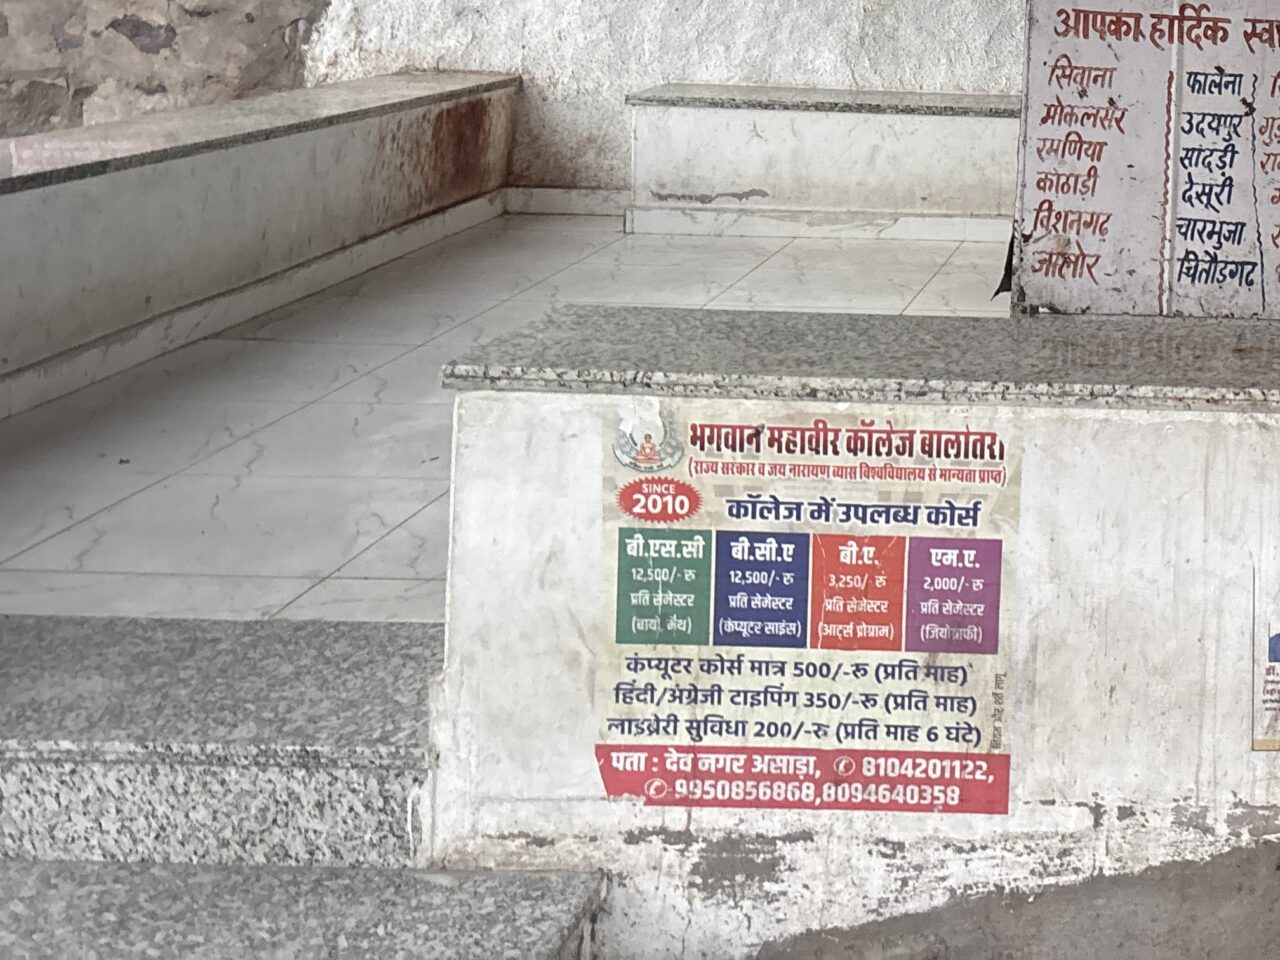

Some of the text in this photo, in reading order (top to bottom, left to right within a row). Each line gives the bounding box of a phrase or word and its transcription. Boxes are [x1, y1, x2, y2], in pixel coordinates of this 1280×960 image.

[1054, 9, 1143, 42] आपका
[1150, 3, 1231, 51] हार्दिक
[1048, 54, 1117, 89] सिवाना
[1186, 71, 1243, 95] फालना
[1181, 112, 1244, 142] उदयपुर
[1036, 130, 1108, 162] रमणिया
[1182, 171, 1234, 213] देसूरी
[1176, 217, 1246, 250] चारभुजा
[1031, 240, 1101, 285] जालोर
[690, 423, 764, 452] भगवान
[768, 419, 841, 455] महावीर
[846, 419, 916, 458] कॉलेज
[688, 457, 718, 477] (राज्य
[721, 461, 755, 476] सरकार
[758, 464, 765, 475] व
[768, 463, 785, 476] जय
[789, 463, 830, 478] नारायण
[833, 466, 857, 479] व्यास
[928, 464, 936, 481] से
[939, 468, 976, 482] मान्यता
[632, 494, 689, 514] 2010
[642, 484, 675, 493] SINCE
[726, 494, 982, 526] कॉलेज में उपलब्ध कोर्स
[626, 534, 705, 558] बी.एस.सी
[731, 536, 795, 562] बी.सी.ए
[930, 548, 980, 568] एम.ए.
[631, 590, 695, 606] प्रति सेमेस्टर
[729, 593, 793, 609] प्रति सेमेस्टर
[824, 597, 889, 613] प्रति सेमेस्टर
[921, 600, 985, 616] प्रति सेमेस्टर
[626, 653, 693, 679] कंप्यूटर
[699, 653, 744, 675] कोर्स
[749, 660, 786, 676] मात्र
[875, 659, 919, 683] (प्रति
[924, 667, 967, 685] माह)
[614, 680, 723, 706] हिंदी/अंग्रेजी
[730, 683, 799, 707] टाइपिंग
[884, 690, 930, 714] (प्रति
[935, 697, 976, 715] माह)
[685, 715, 748, 742] सुविधा
[836, 718, 879, 743] (प्रति
[885, 726, 920, 742] माह
[927, 728, 938, 742] 6
[945, 721, 981, 748] घंटे)
[611, 752, 648, 771] पता
[664, 748, 694, 772] देव
[698, 756, 746, 773] नगर
[862, 756, 994, 783] 8104201122,
